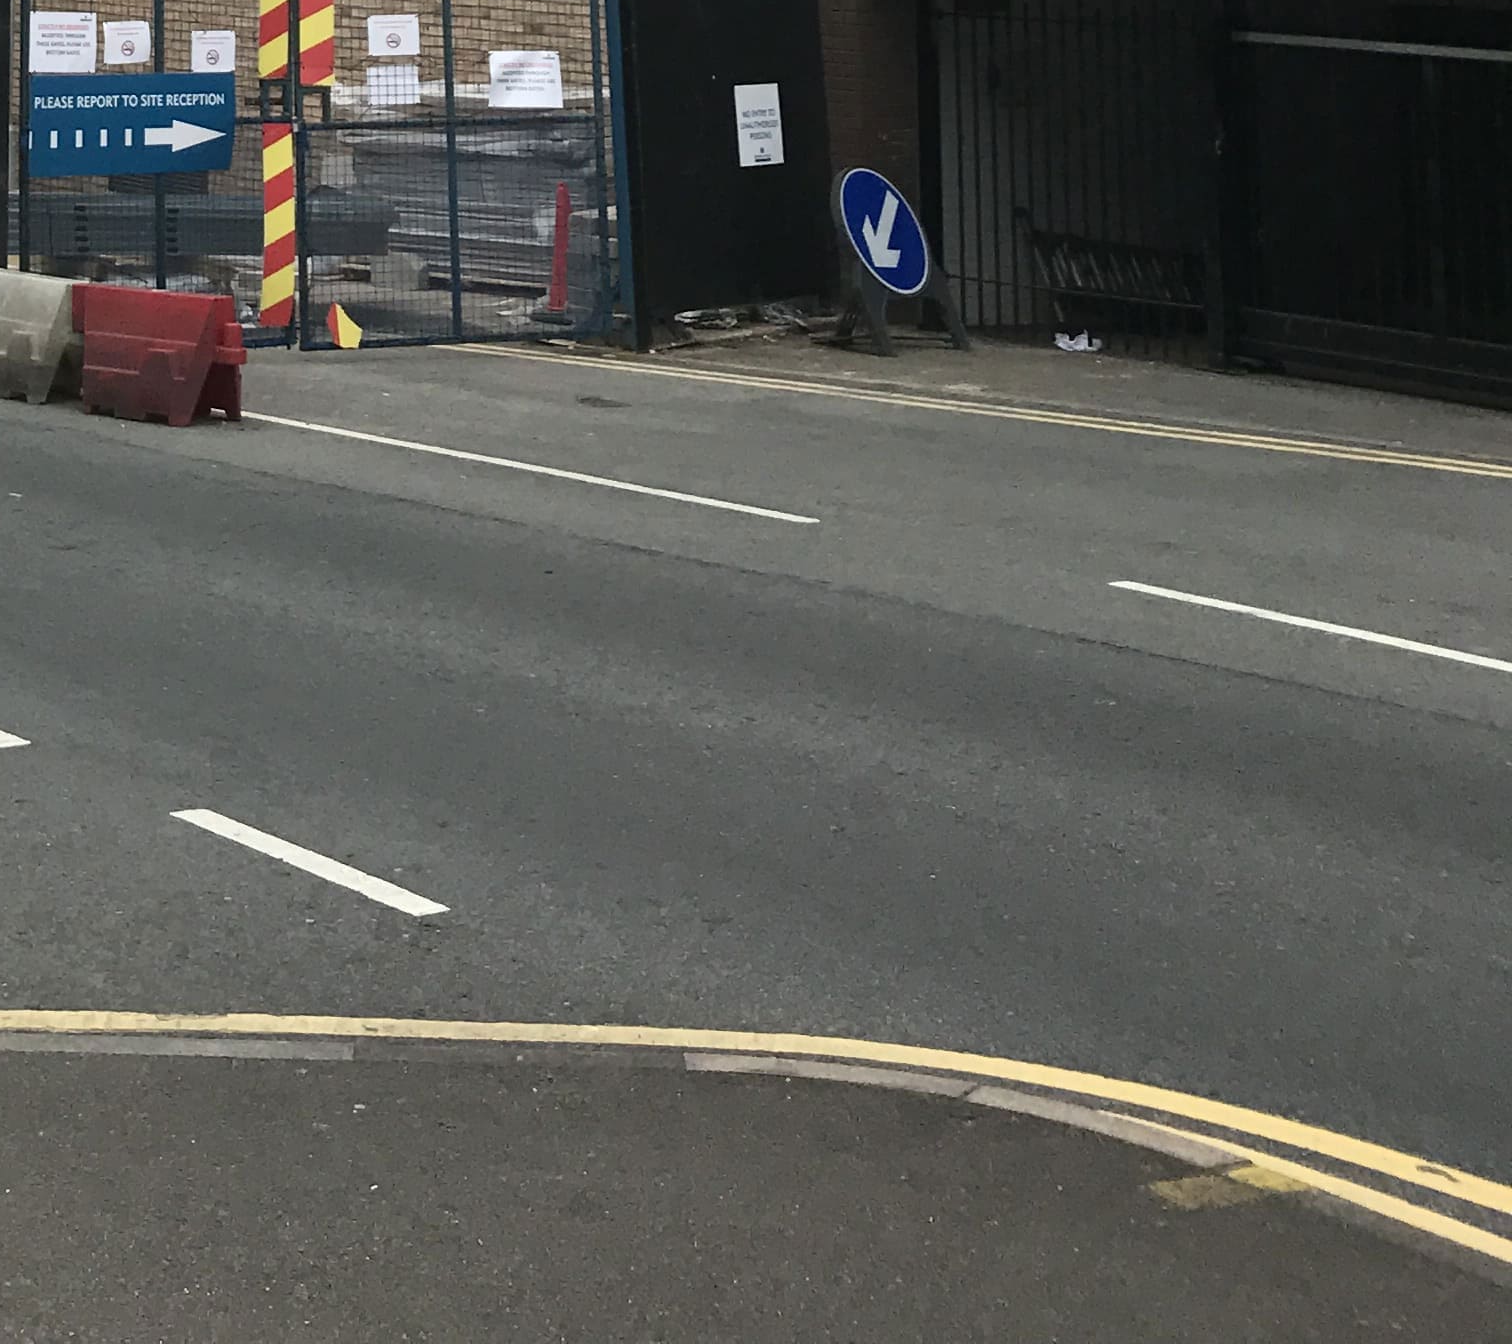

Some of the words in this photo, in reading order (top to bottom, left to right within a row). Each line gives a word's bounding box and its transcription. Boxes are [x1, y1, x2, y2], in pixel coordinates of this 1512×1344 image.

[34, 95, 74, 109] PLEASE
[77, 95, 119, 108] REPORT
[122, 94, 138, 107] TO
[140, 94, 164, 107] SITE
[166, 93, 225, 106] RECEPTION
